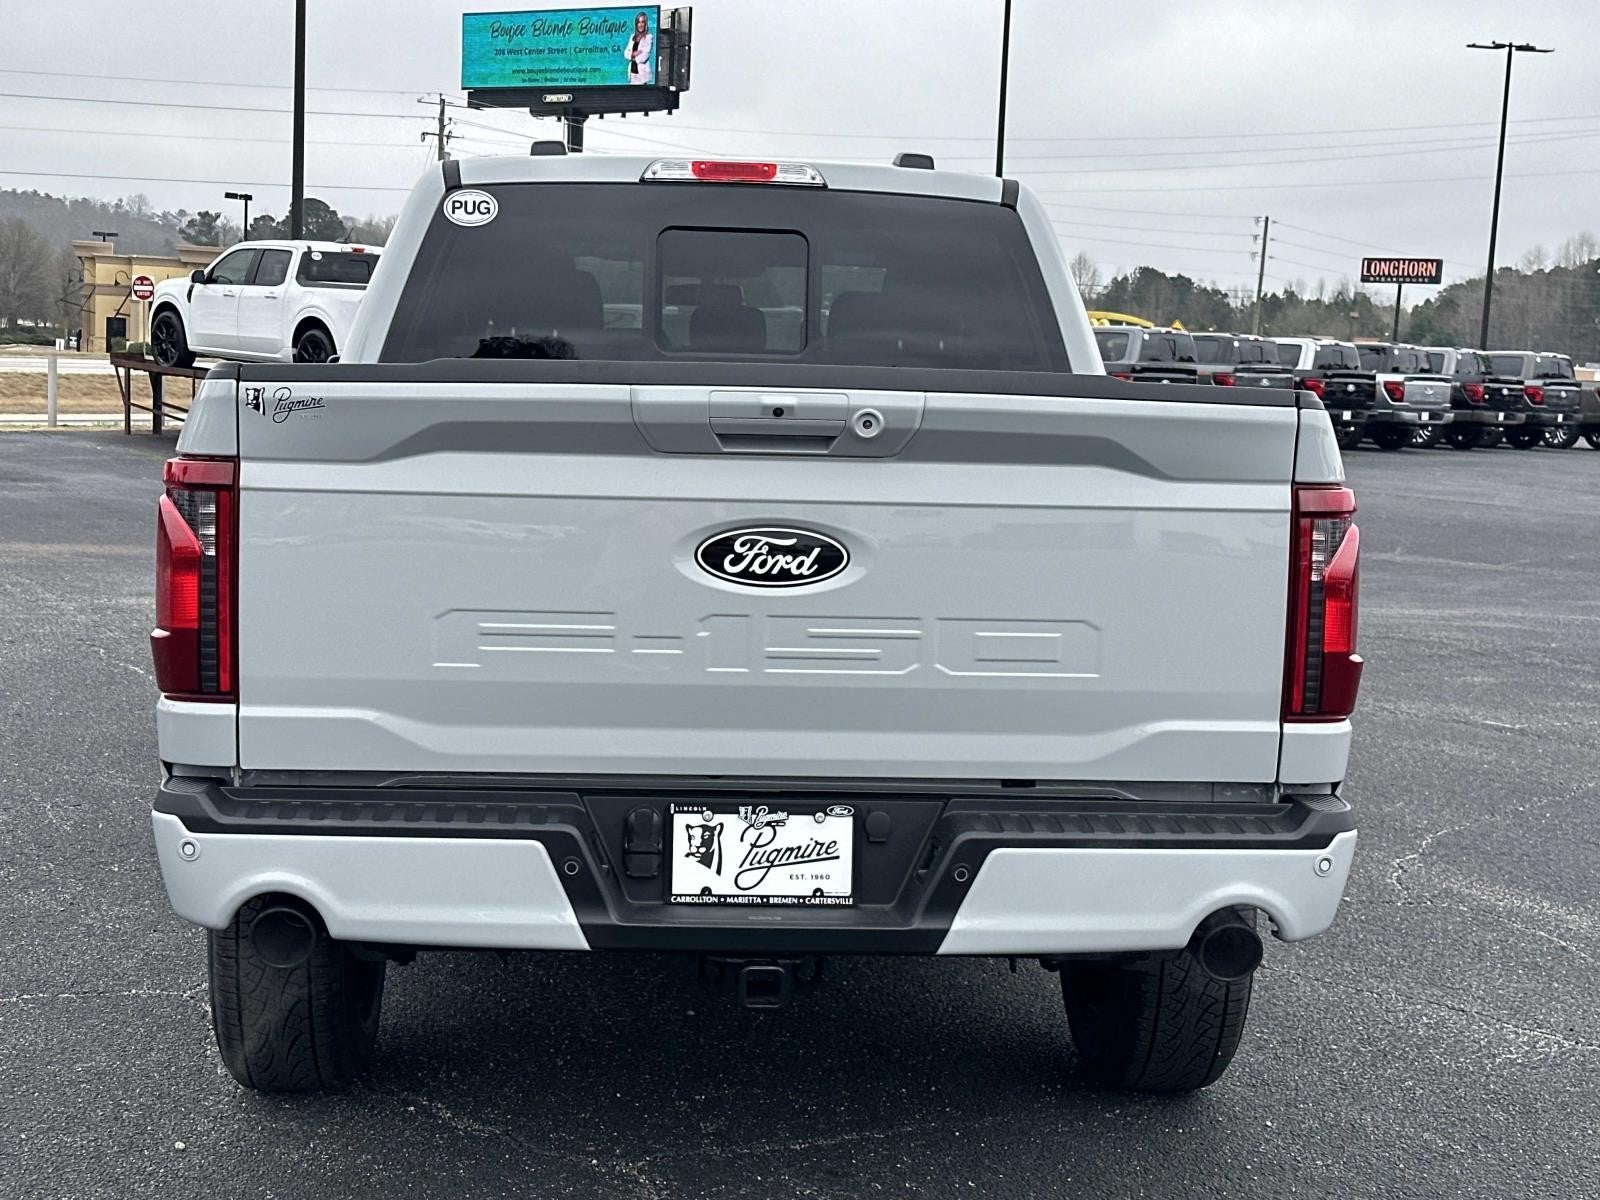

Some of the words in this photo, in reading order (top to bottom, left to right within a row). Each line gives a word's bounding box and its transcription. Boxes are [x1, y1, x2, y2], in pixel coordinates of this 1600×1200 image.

[490, 20, 526, 43] Boujee
[532, 18, 573, 37] Blonde
[578, 16, 628, 39] Boutique
[547, 47, 567, 55] Street
[612, 45, 622, 53] GA
[452, 200, 491, 215] PUG
[1363, 260, 1437, 276] LONGHORN
[272, 386, 326, 424] Pugmire
[723, 535, 822, 576] Ford
[432, 608, 1101, 678] F-150
[734, 824, 840, 891] Pugmire
[726, 896, 761, 904] MARIETTA
[805, 897, 853, 905] CARTERSVILLE
